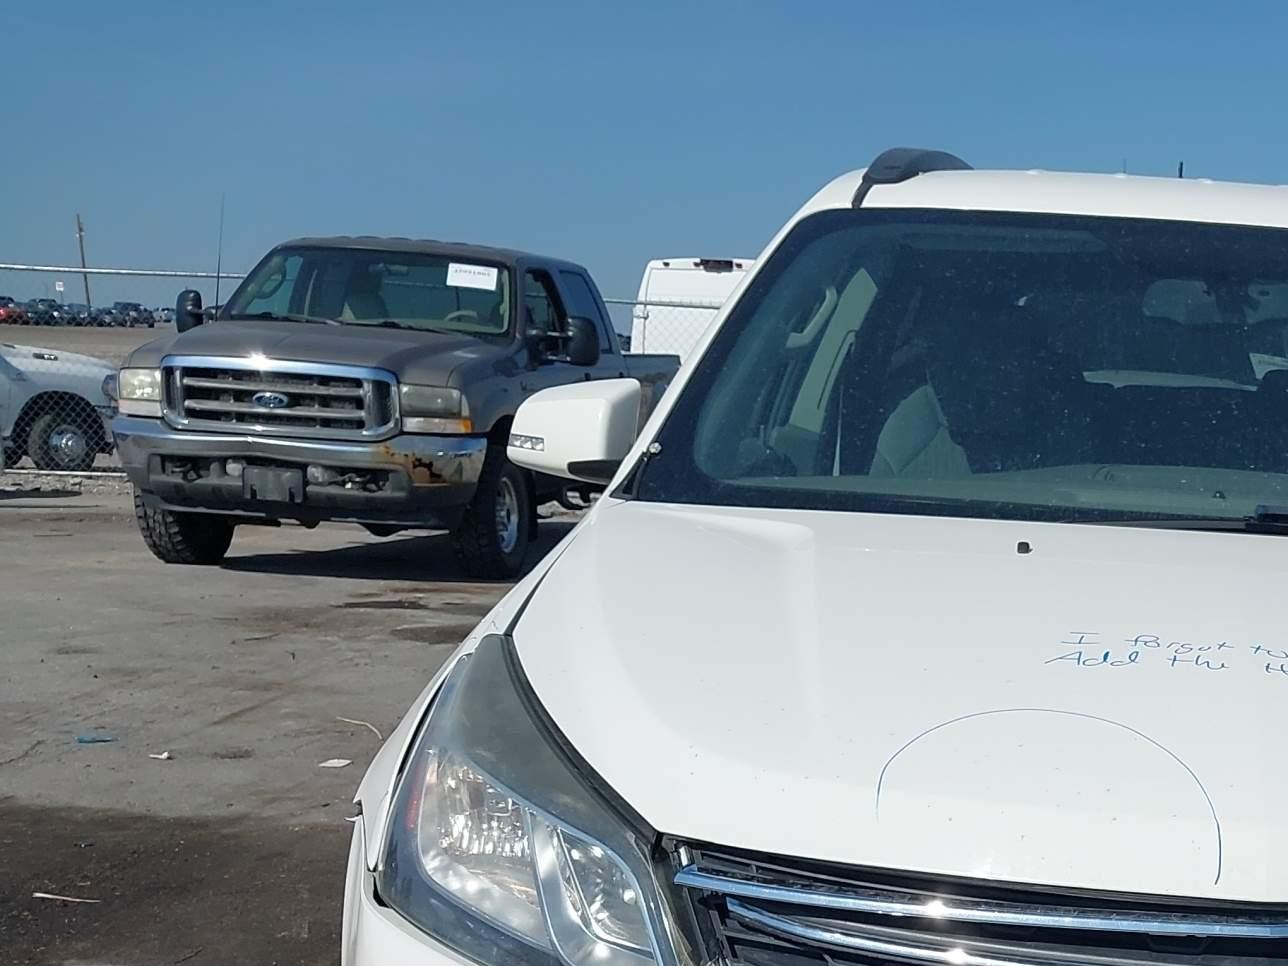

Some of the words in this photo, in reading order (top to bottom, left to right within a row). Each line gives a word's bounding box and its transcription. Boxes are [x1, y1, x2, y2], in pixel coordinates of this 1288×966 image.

[1060, 631, 1100, 645] I
[1249, 644, 1288, 659] to
[1044, 650, 1140, 667] Add
